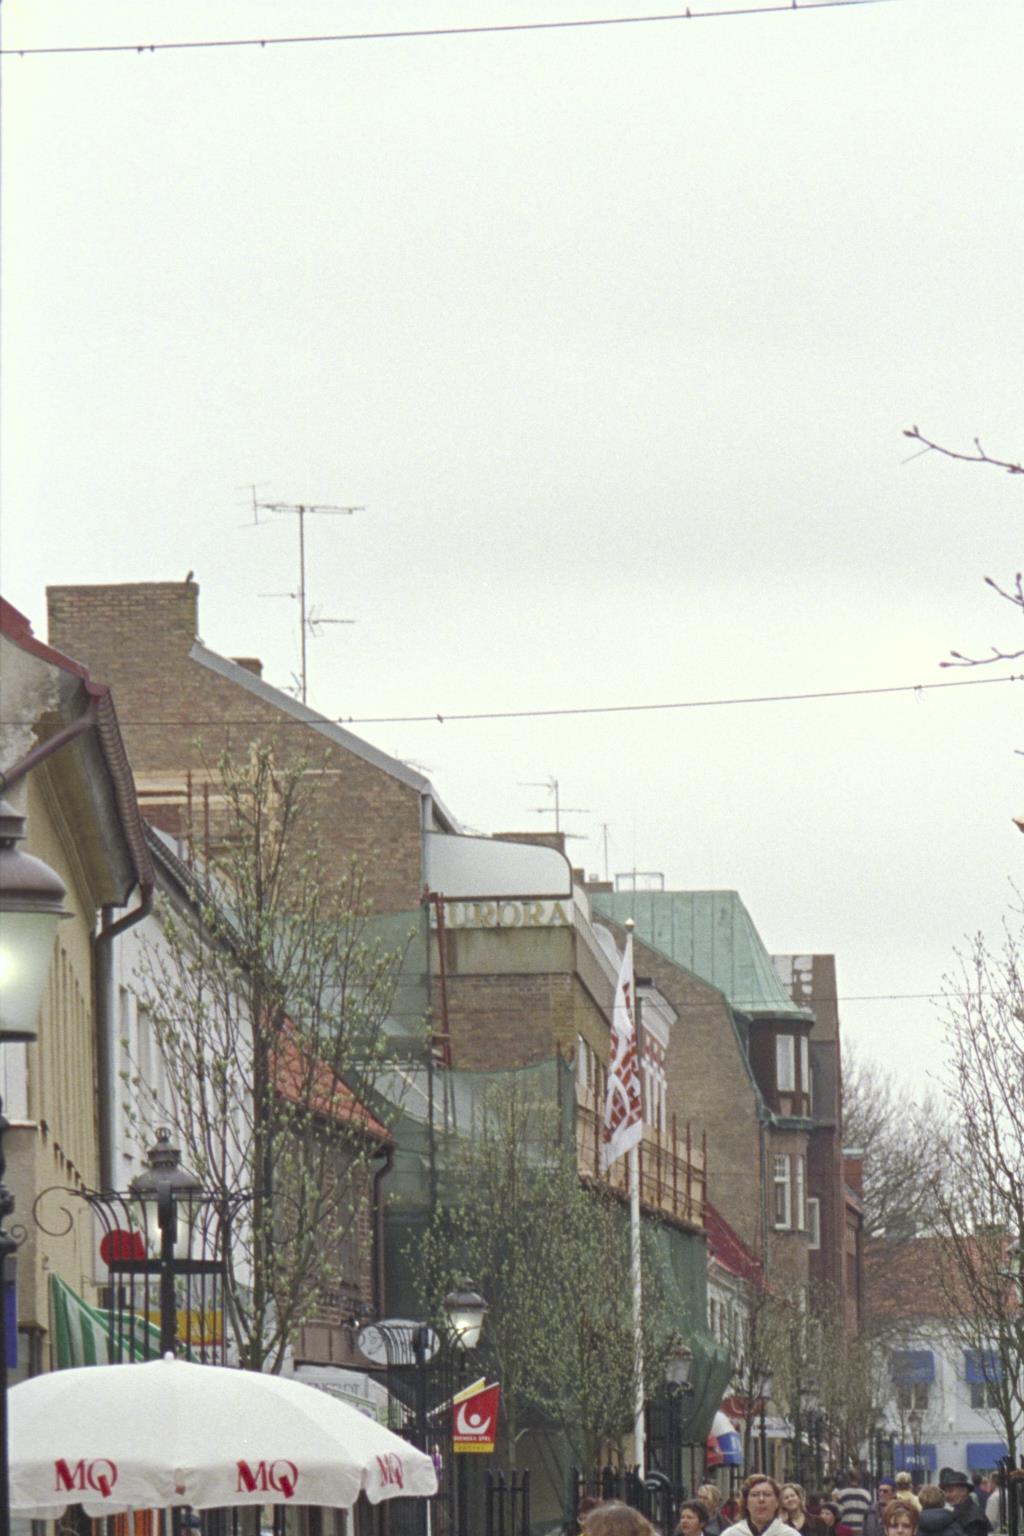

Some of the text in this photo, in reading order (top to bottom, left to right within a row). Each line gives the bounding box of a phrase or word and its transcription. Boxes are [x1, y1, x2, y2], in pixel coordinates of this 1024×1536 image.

[54, 1458, 118, 1498] MQ
[235, 1459, 299, 1499] MQ
[375, 1452, 404, 1489] MQ
